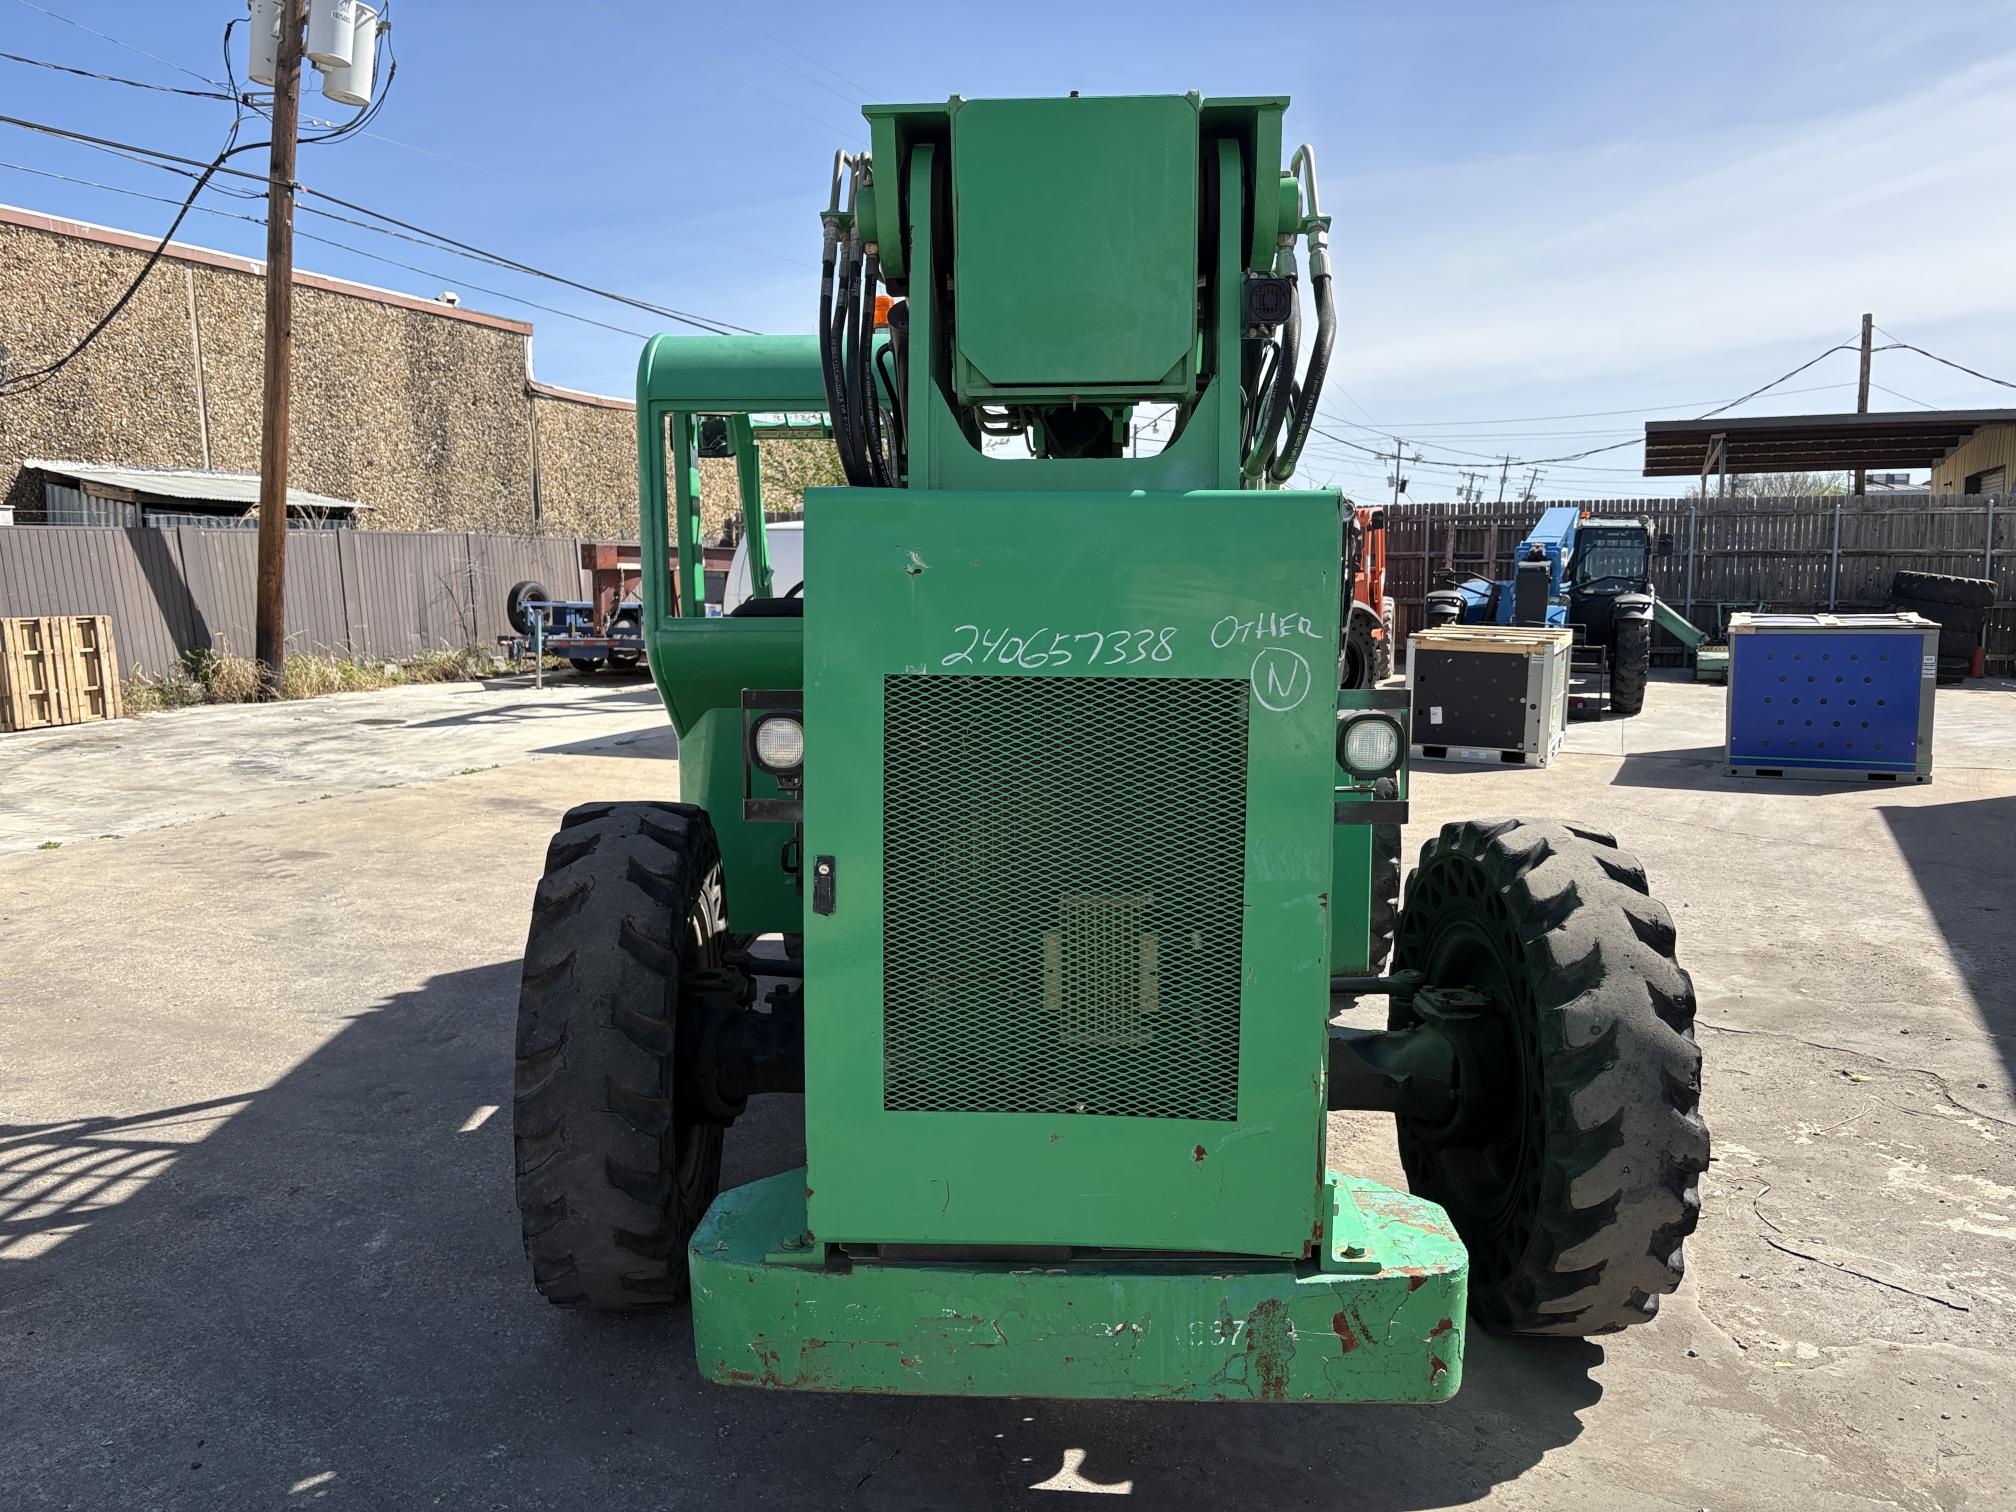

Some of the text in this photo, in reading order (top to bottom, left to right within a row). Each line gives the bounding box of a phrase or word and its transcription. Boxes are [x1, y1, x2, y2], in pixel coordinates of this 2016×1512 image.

[941, 624, 1178, 668] 240657338
[1210, 612, 1323, 648] OTHER
[1267, 659, 1298, 697] N
